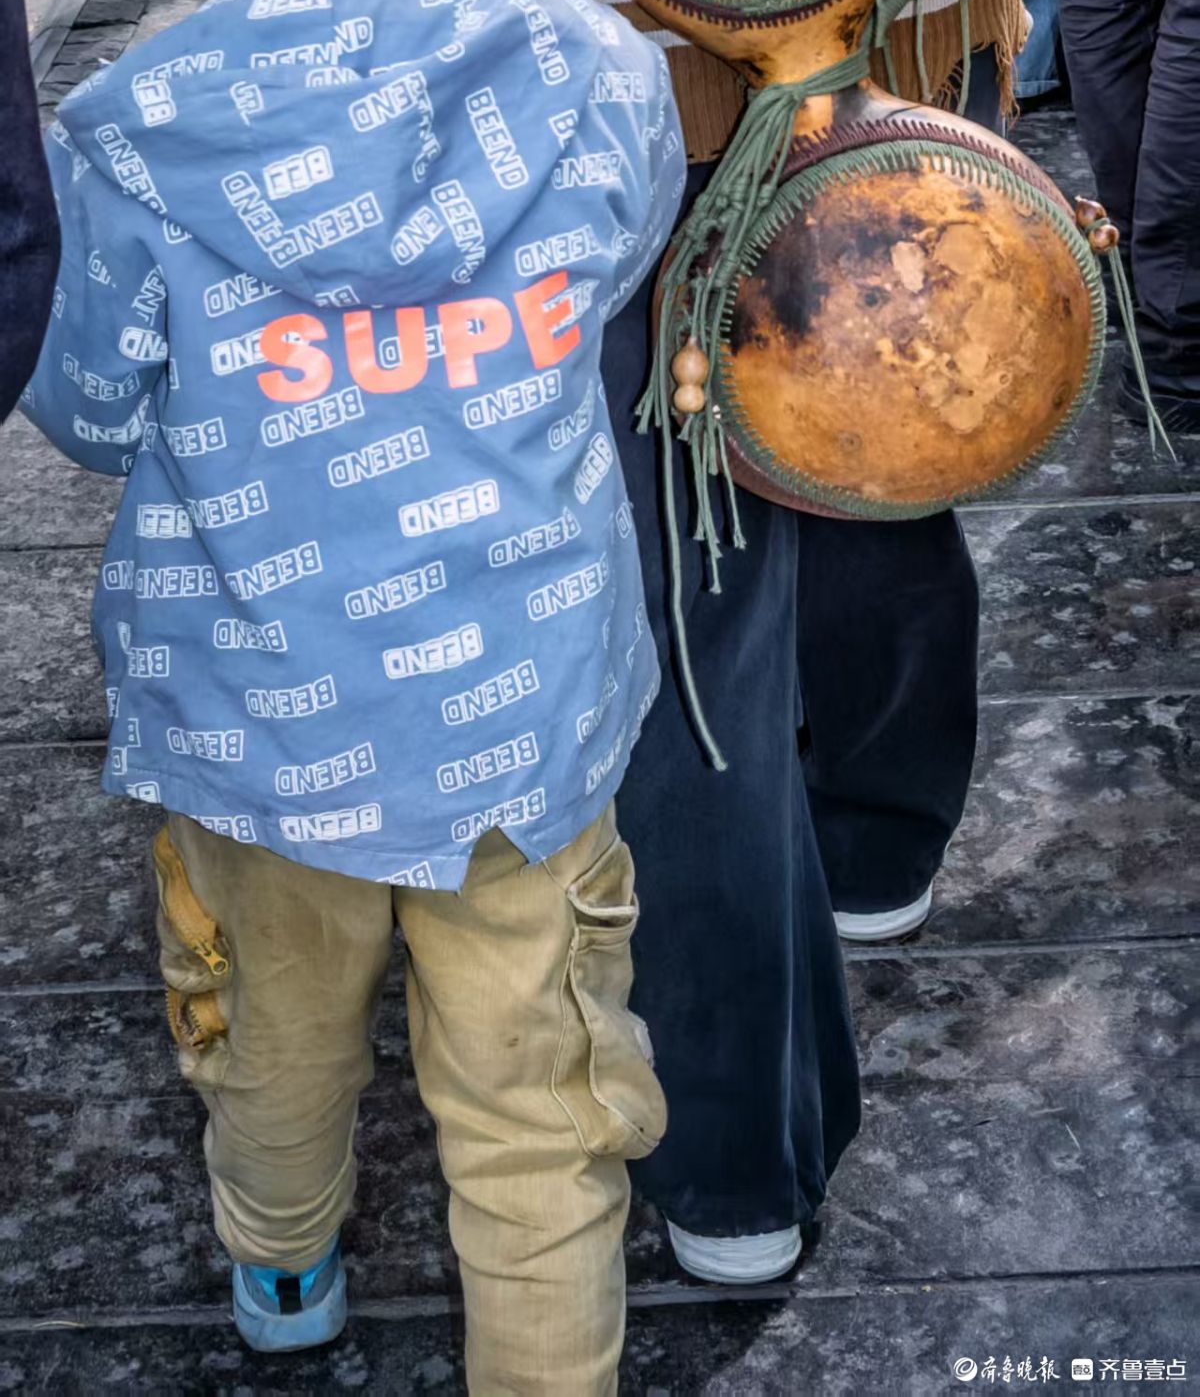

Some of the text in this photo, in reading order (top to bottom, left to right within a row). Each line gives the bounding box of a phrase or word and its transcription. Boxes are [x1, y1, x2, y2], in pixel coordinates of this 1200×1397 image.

[465, 86, 530, 190] BEEND
[257, 269, 581, 402] SUPE
[260, 385, 365, 448] BEEND
[463, 368, 562, 430] BEEND
[327, 425, 431, 488] BEEND
[398, 479, 500, 538] BEEND
[135, 565, 219, 599] BEEND
[225, 540, 323, 600] BEEND
[345, 560, 447, 620] BEEND
[382, 622, 484, 680] BEEND
[246, 674, 337, 718] BEEND
[442, 659, 540, 725] BEEND
[275, 742, 376, 796] BEEND
[437, 731, 540, 794] BEEND
[279, 803, 381, 842] BEEND
